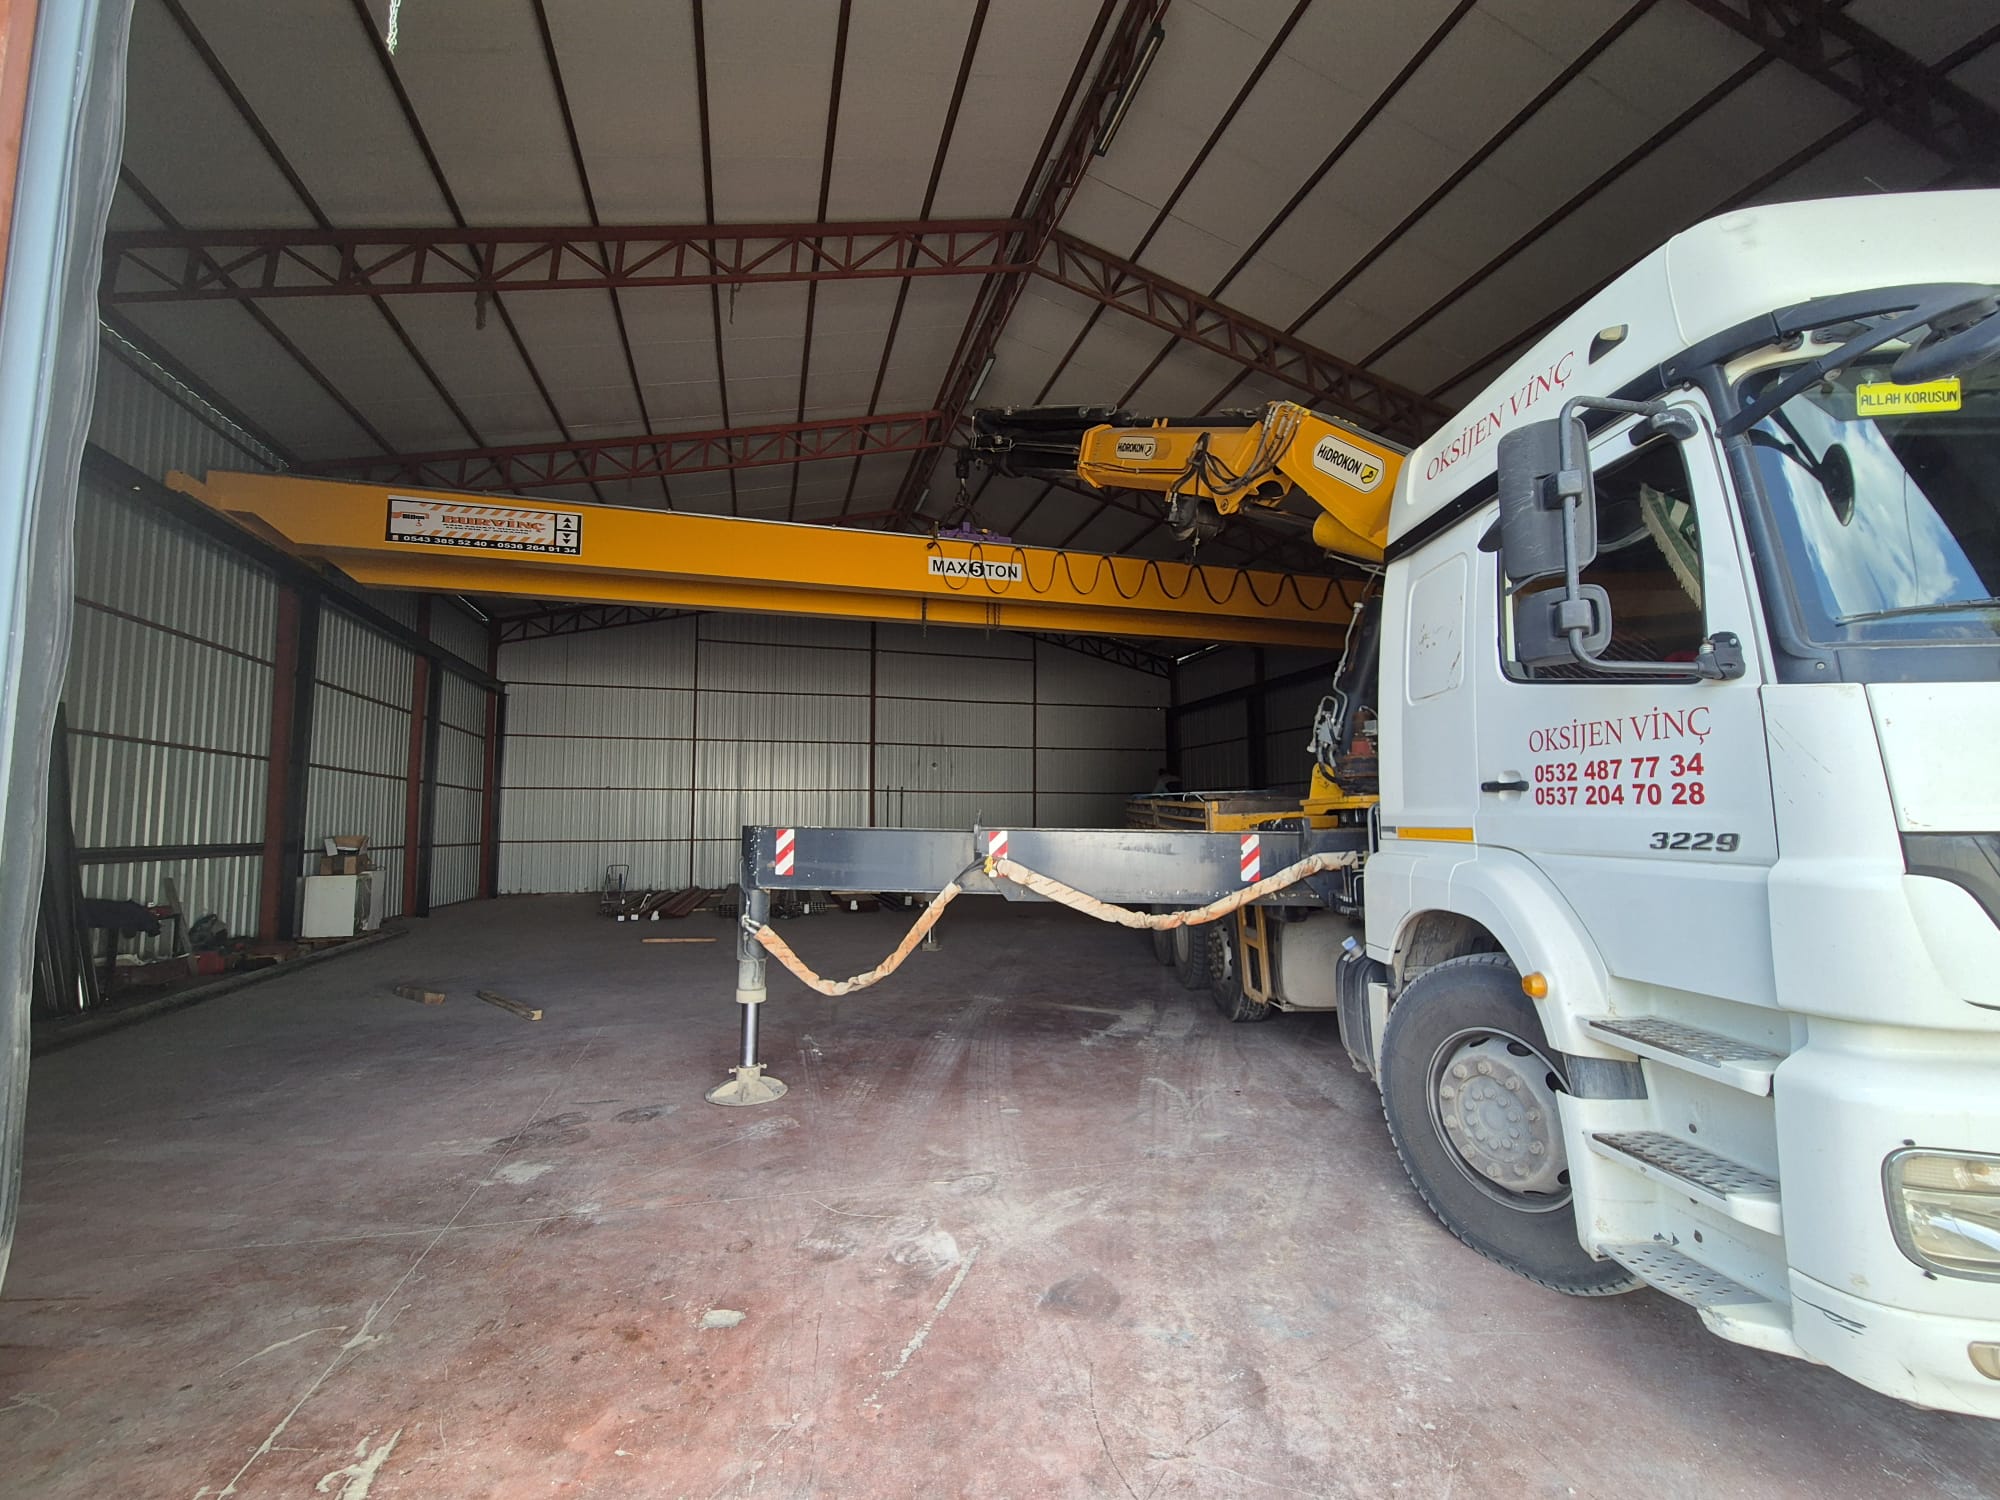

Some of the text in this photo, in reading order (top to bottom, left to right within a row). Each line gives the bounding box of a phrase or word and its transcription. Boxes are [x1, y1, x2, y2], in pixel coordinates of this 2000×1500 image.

[1861, 391, 1957, 406] ALLAH KORUSUN
[1427, 351, 1574, 480] OKSİJEN VİNÇ
[403, 535, 431, 543] 0543
[497, 541, 523, 549] 0536
[932, 559, 967, 575] MAX
[986, 564, 1018, 578] TON
[1529, 706, 1711, 754] OKSİJEN VİNÇ
[1534, 752, 1704, 783] 0532 487 77 34
[1535, 782, 1705, 805] 0537 204 70 28
[1649, 832, 1740, 852] 3229
